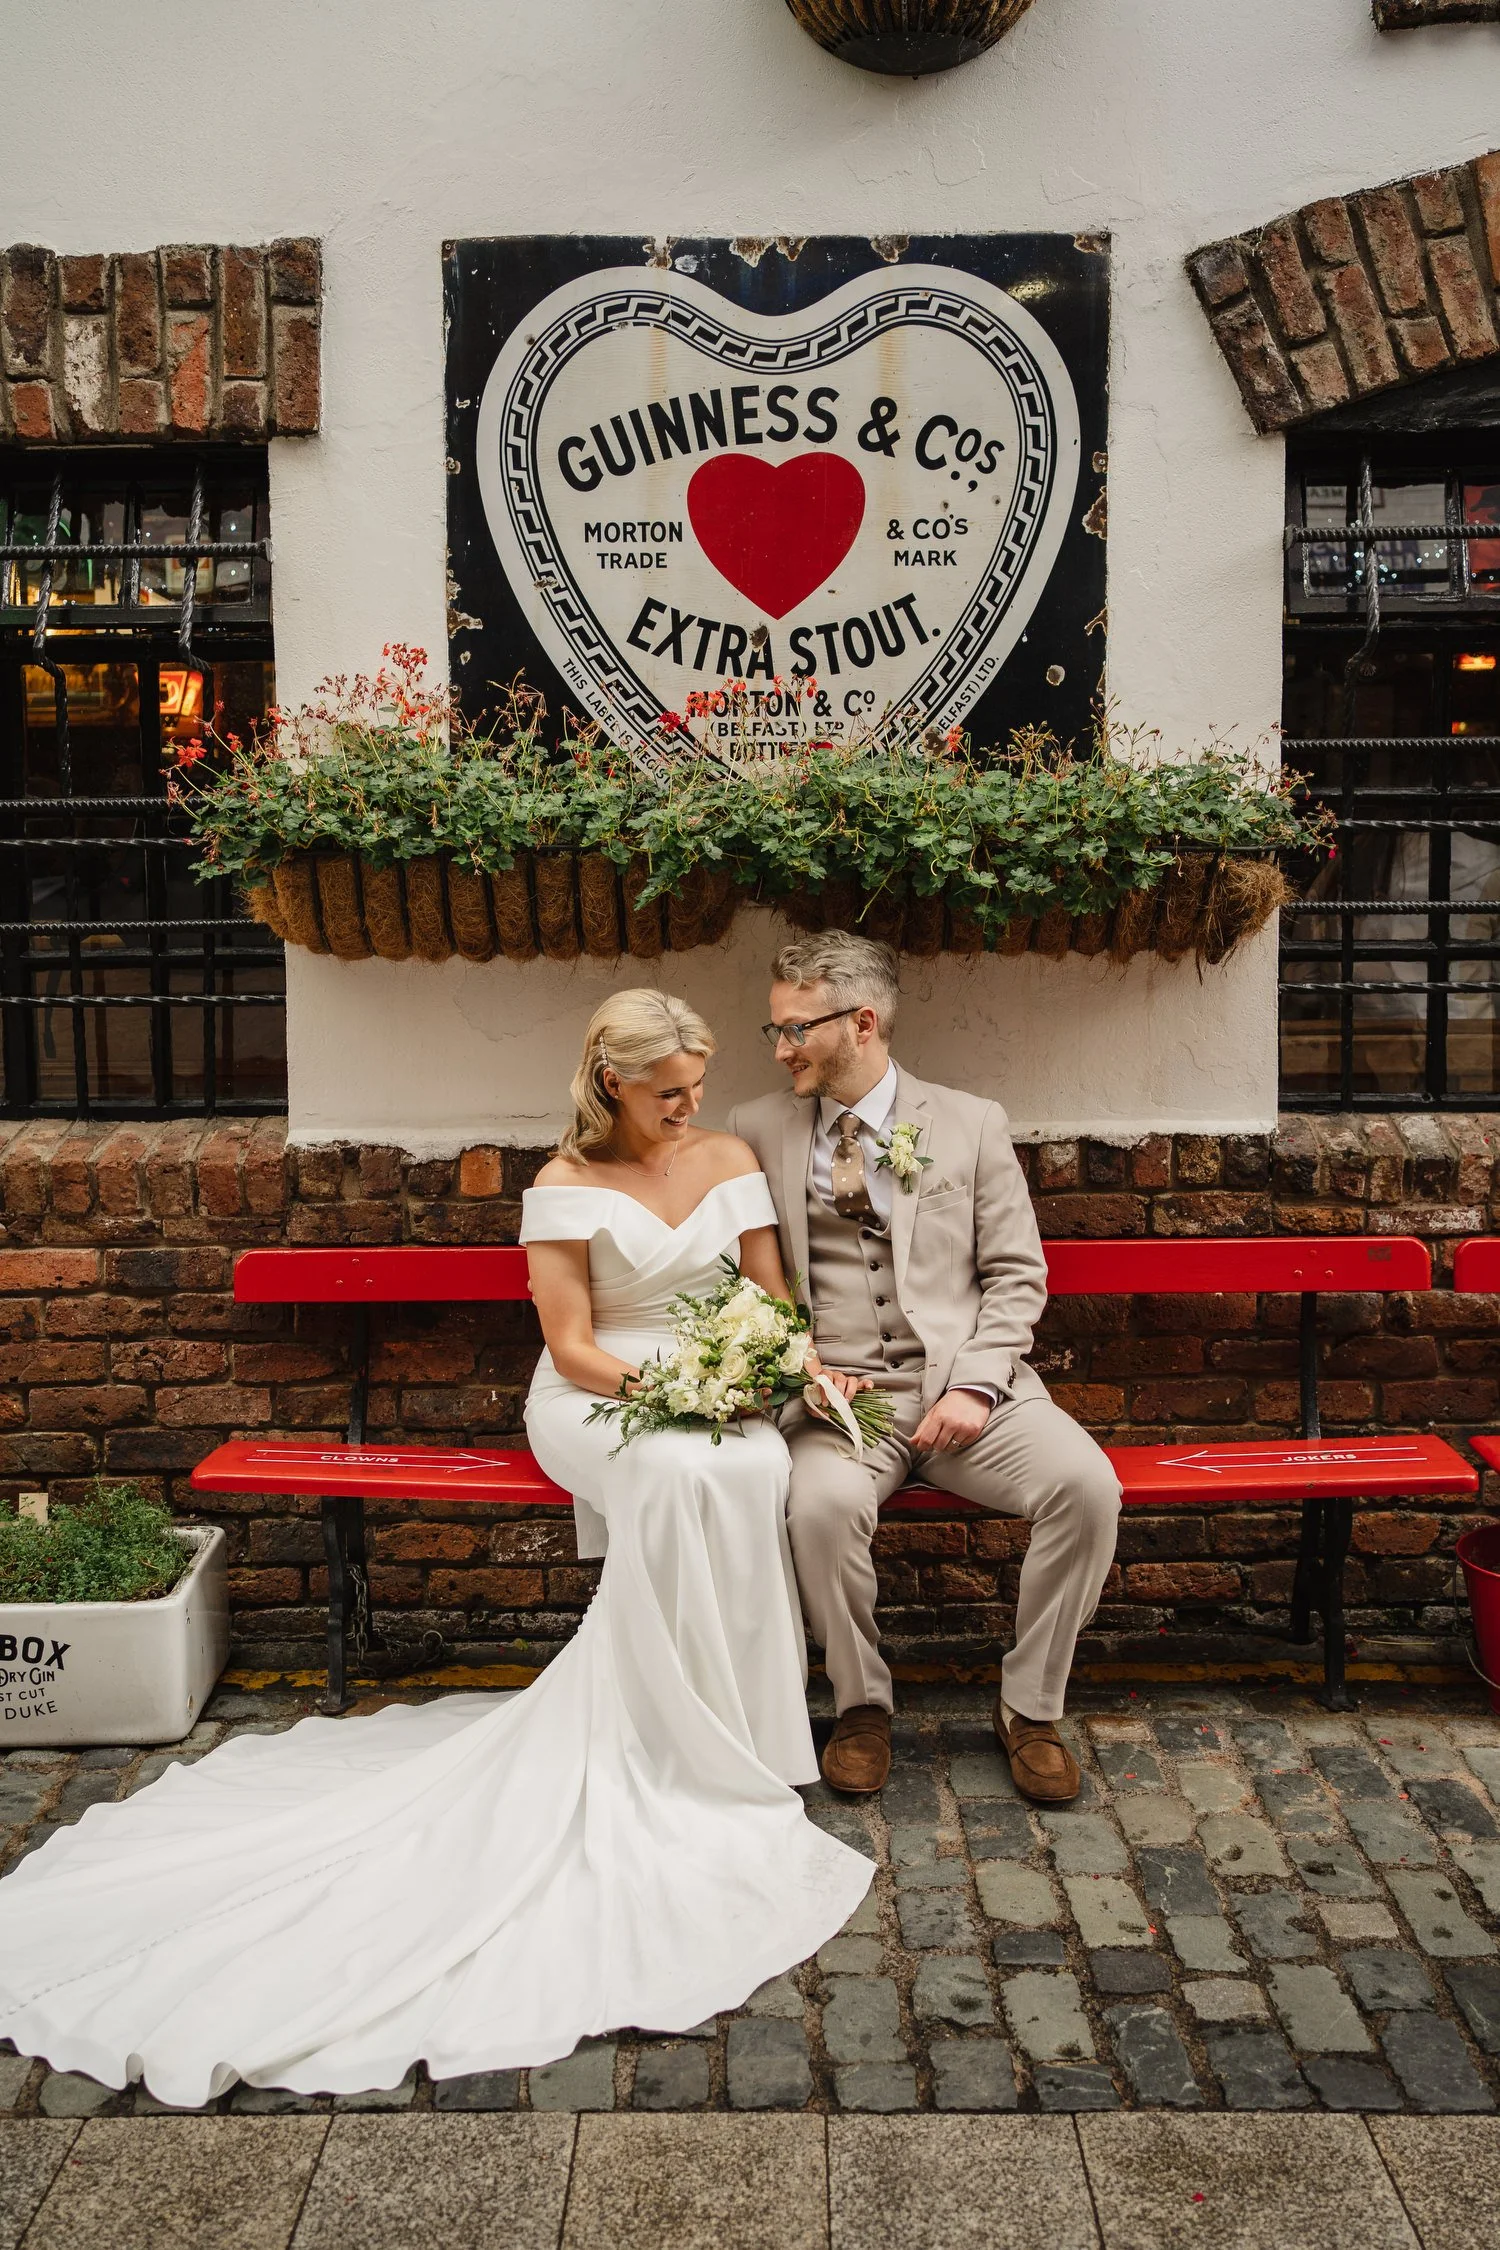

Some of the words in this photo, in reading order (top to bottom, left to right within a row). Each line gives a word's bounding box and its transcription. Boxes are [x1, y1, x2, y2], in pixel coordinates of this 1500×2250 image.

[558, 384, 840, 492] GUINNESS
[857, 396, 901, 458] &
[584, 521, 684, 543] MORTON
[886, 518, 905, 540] &
[597, 552, 668, 569] TRADE
[894, 550, 957, 567] MARK
[626, 596, 775, 680] EXTRA
[789, 592, 941, 676] STOUT.
[975, 656, 1000, 682] LTD.
[562, 658, 588, 690] THIS
[585, 691, 616, 732] LABEL
[618, 730, 633, 746] IS
[813, 690, 832, 717] &
[320, 1455, 399, 1463] CLOWNS
[1282, 1454, 1357, 1462] JOKERS
[29, 1667, 55, 1685] GIN
[18, 1687, 45, 1701] CUT
[4, 1700, 58, 1720] DUKE
